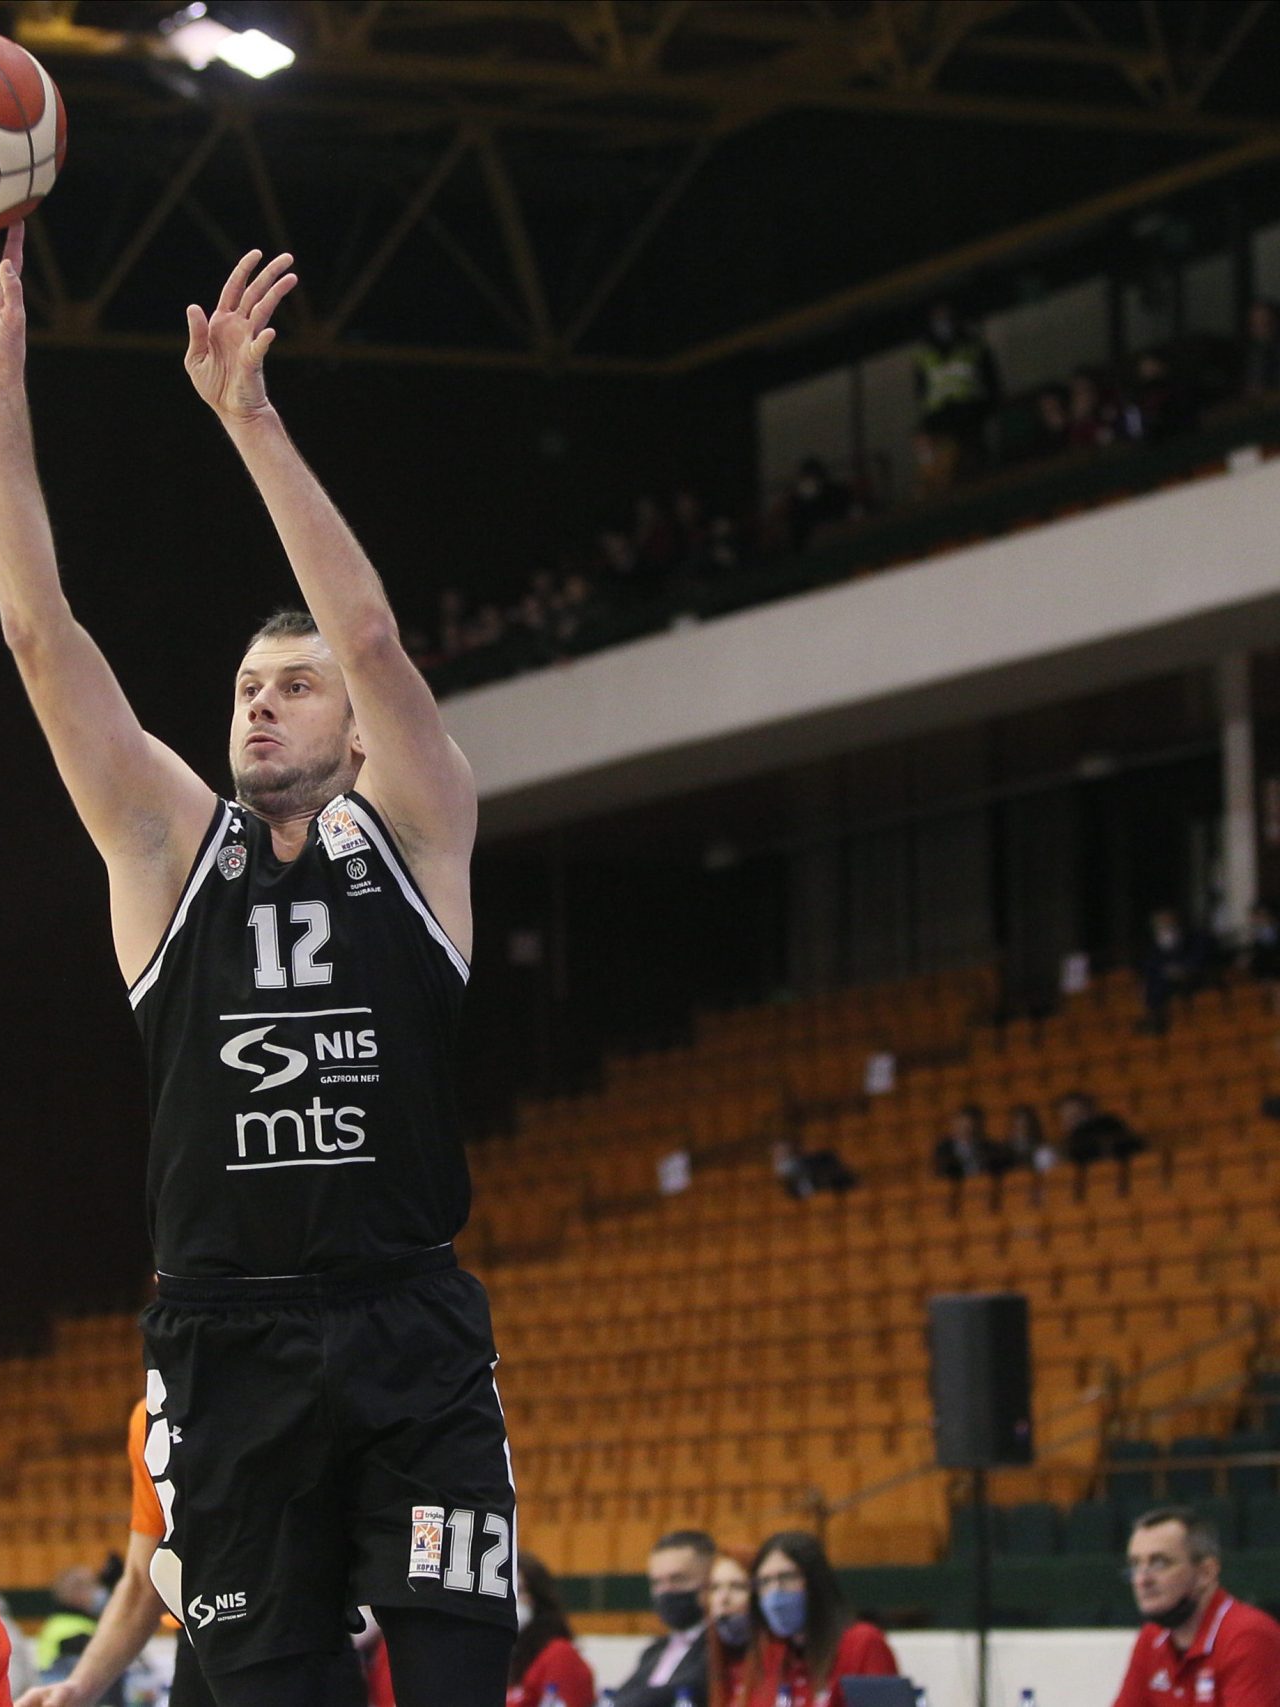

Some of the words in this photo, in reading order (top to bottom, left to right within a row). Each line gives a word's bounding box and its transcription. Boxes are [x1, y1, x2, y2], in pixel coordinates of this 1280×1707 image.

[247, 900, 333, 989] 12
[314, 1029, 379, 1060] NIS
[320, 1074, 359, 1084] GAZPROM
[360, 1074, 380, 1083] NEFT
[235, 1096, 367, 1158] mts
[443, 1508, 509, 1598] 12
[215, 1591, 247, 1610] NIS
